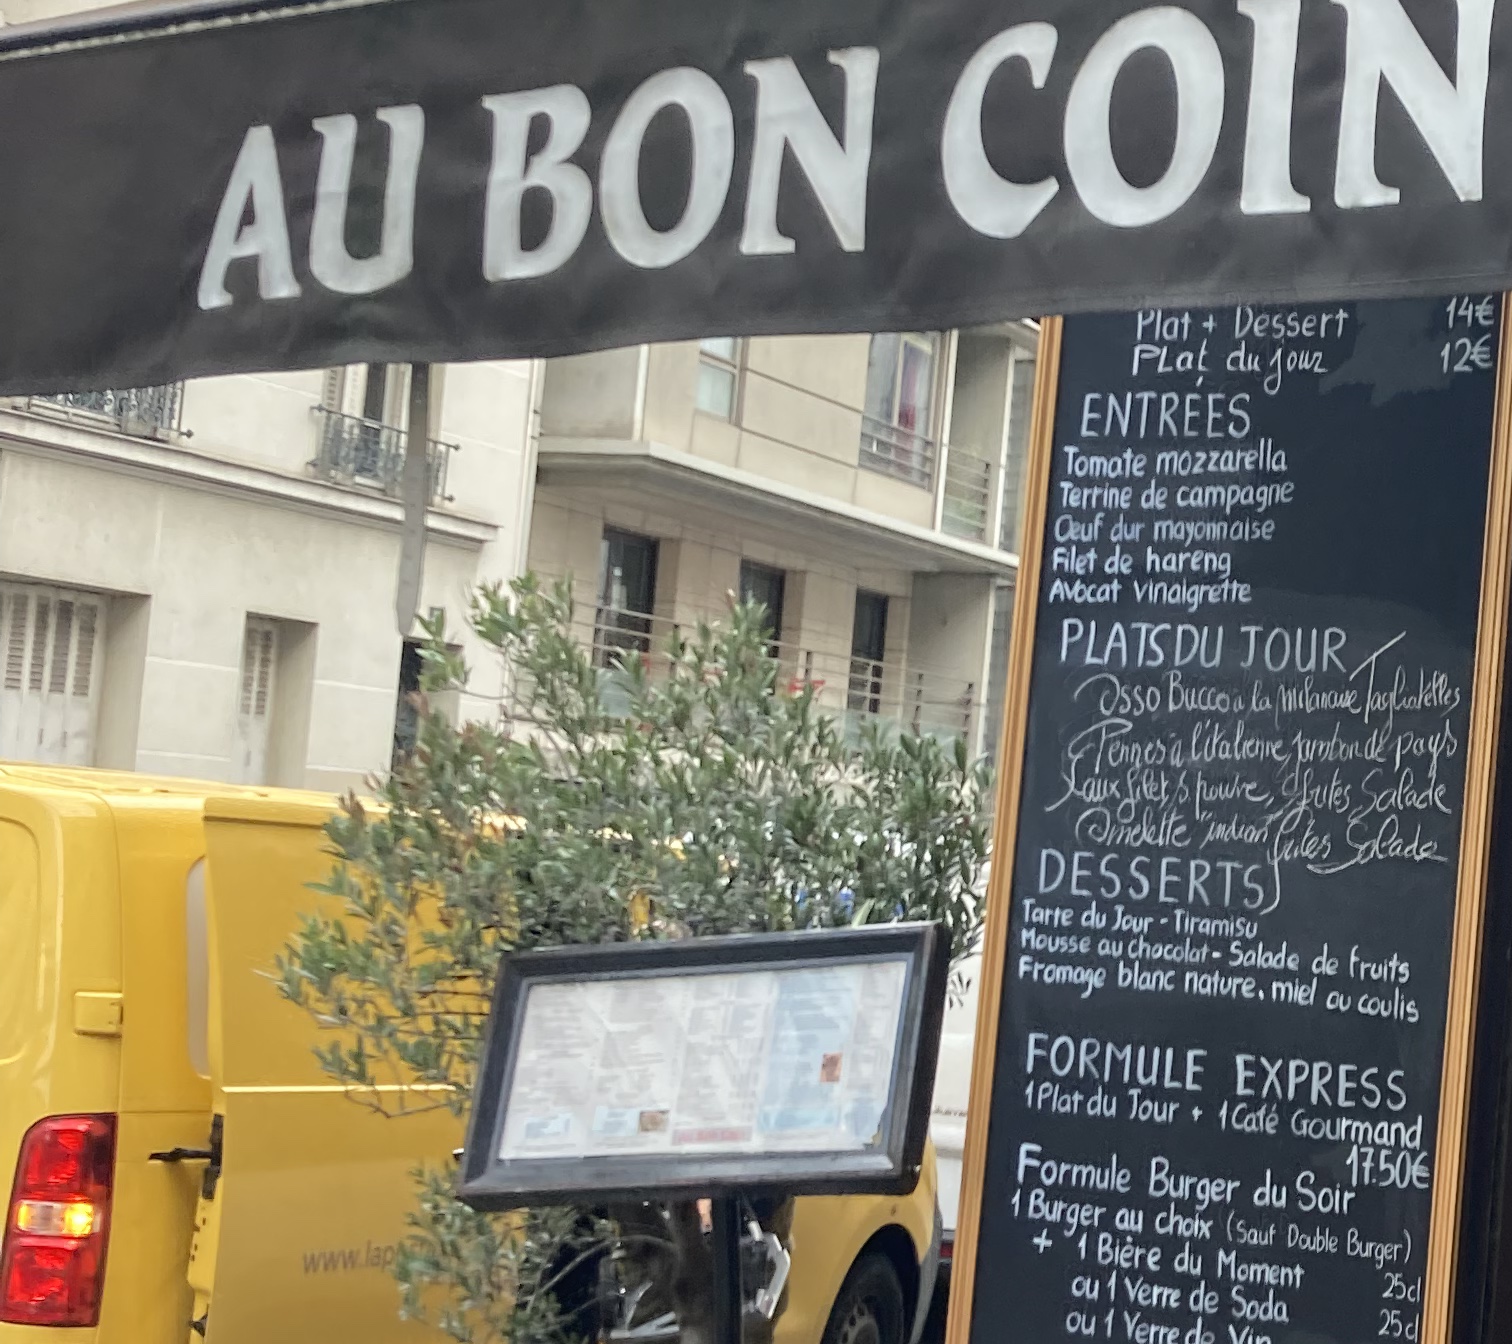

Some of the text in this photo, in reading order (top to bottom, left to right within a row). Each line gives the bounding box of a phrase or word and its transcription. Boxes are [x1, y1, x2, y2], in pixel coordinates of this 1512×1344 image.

[197, 102, 424, 312] AU
[481, 44, 880, 286] BON
[1137, 308, 1191, 342] Plat
[1234, 305, 1349, 339] Dessert
[1446, 296, 1495, 329] 14€
[1226, 340, 1260, 372] du
[1441, 334, 1493, 374] 12€
[1080, 375, 1251, 438] ENTRÉES
[1064, 438, 1288, 478] Tomate mozzarella
[1060, 476, 1295, 514] Terrine de campagne
[1111, 512, 1145, 542] dur
[1154, 517, 1275, 546] mayonnaise
[1053, 546, 1231, 578] Filet de hareng
[1049, 578, 1252, 612] Avocat vinaigrette
[1060, 618, 1347, 672] PLATS DU JOUR
[1074, 673, 1161, 716] Osso
[1168, 670, 1230, 713] Bucco
[1251, 679, 1272, 712] la
[1365, 728, 1387, 762] de
[1076, 807, 1191, 846] Omelette
[1038, 849, 1264, 910] DESSERTS
[1022, 898, 1074, 928] Tarte
[1081, 900, 1107, 929] du
[1112, 904, 1154, 934] Jour
[1174, 908, 1258, 939] Tiramisu
[1021, 927, 1092, 954] Mousse
[1098, 938, 1123, 957] au
[1127, 935, 1210, 963] chocolat
[1229, 940, 1300, 972] Salade
[1312, 943, 1339, 975] de
[1350, 945, 1410, 984] fruits
[1019, 955, 1107, 999] Fromage
[1118, 960, 1176, 991] blanc
[1272, 977, 1317, 1006] miel
[1357, 987, 1420, 1023] coulis
[1026, 1033, 1407, 1112] FORMULE EXPRESS
[1037, 1085, 1083, 1114] Plat
[1088, 1088, 1116, 1118] du
[1128, 1089, 1179, 1123] Jour
[1232, 1102, 1279, 1136] Café
[1291, 1110, 1422, 1150] Gourmand
[1017, 1142, 1356, 1215] Formule Burger du Soir
[1346, 1144, 1430, 1190] 17.50€
[1011, 1189, 1411, 1269] 1 Burger au choix (Sauf Double Burger)
[303, 1239, 396, 1275] www.lap
[1033, 1229, 1053, 1254] +
[1078, 1233, 1087, 1259] 1
[1098, 1233, 1161, 1271] Bière
[1174, 1245, 1201, 1276] du
[1217, 1247, 1305, 1289] Moment
[1072, 1274, 1098, 1300] ou
[1107, 1269, 1117, 1301] 1
[1125, 1278, 1181, 1310] Verre
[1188, 1280, 1219, 1315] de
[1231, 1286, 1289, 1323] Soda
[1066, 1310, 1096, 1336] ou
[1104, 1306, 1113, 1338] 1
